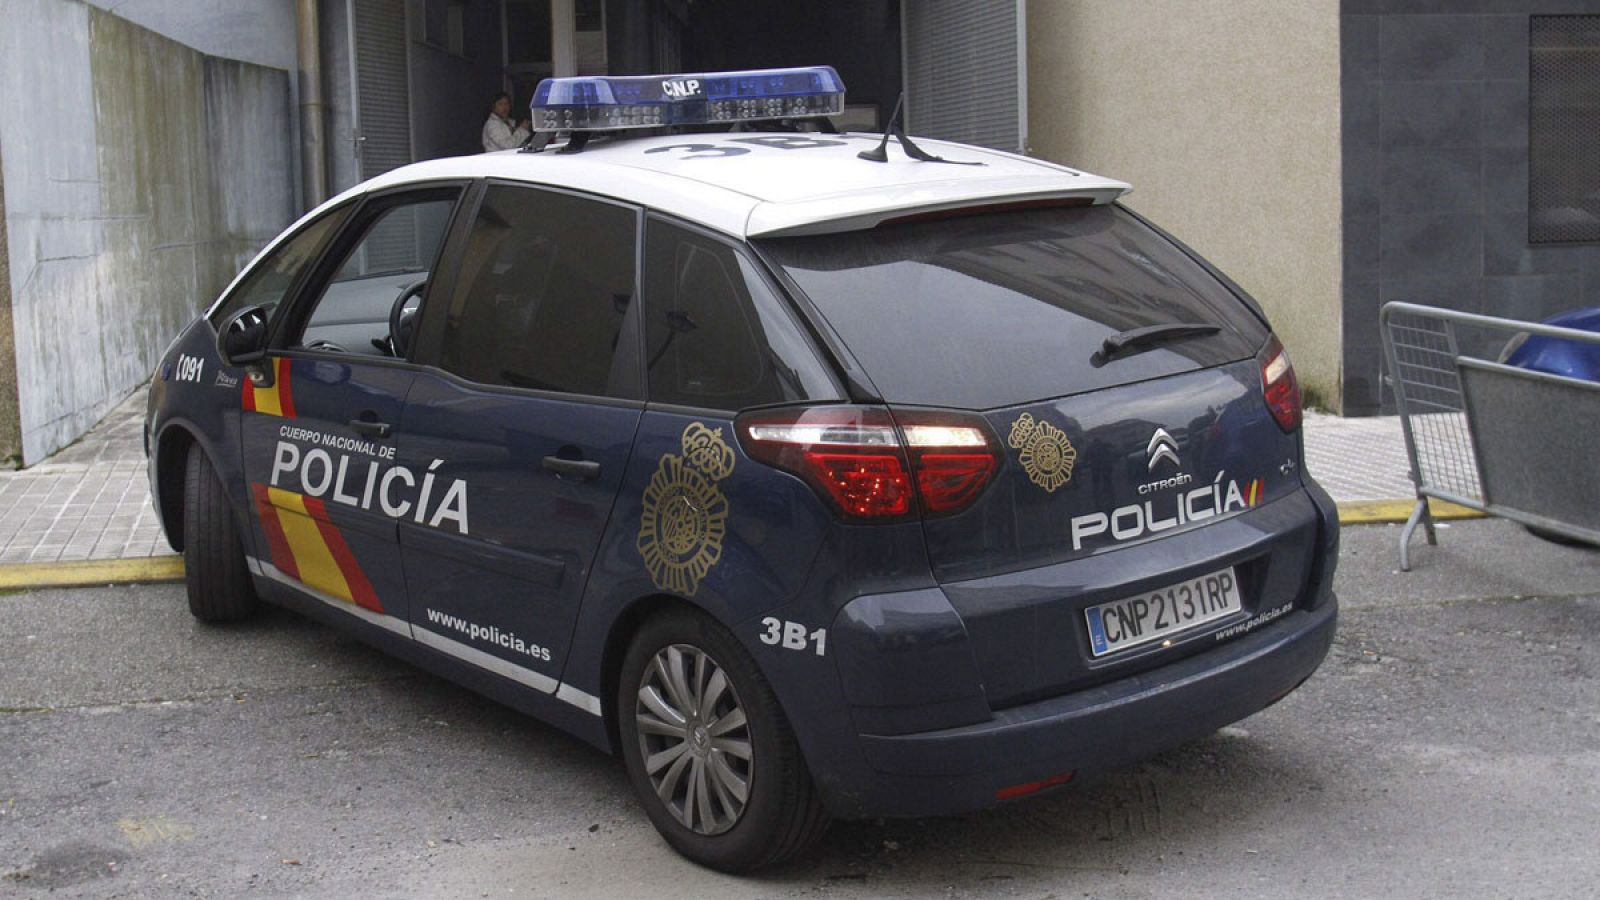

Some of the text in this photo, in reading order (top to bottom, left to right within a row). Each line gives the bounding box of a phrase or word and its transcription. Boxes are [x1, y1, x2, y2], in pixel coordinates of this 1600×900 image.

[280, 425, 396, 460] CUERPO NACIONAL DE
[270, 440, 469, 534] POLICÍA
[1071, 470, 1246, 550] POLICÍA
[427, 608, 551, 661] www.policia.es
[759, 616, 826, 656] 3B1
[1215, 601, 1293, 640] www.policia.es
